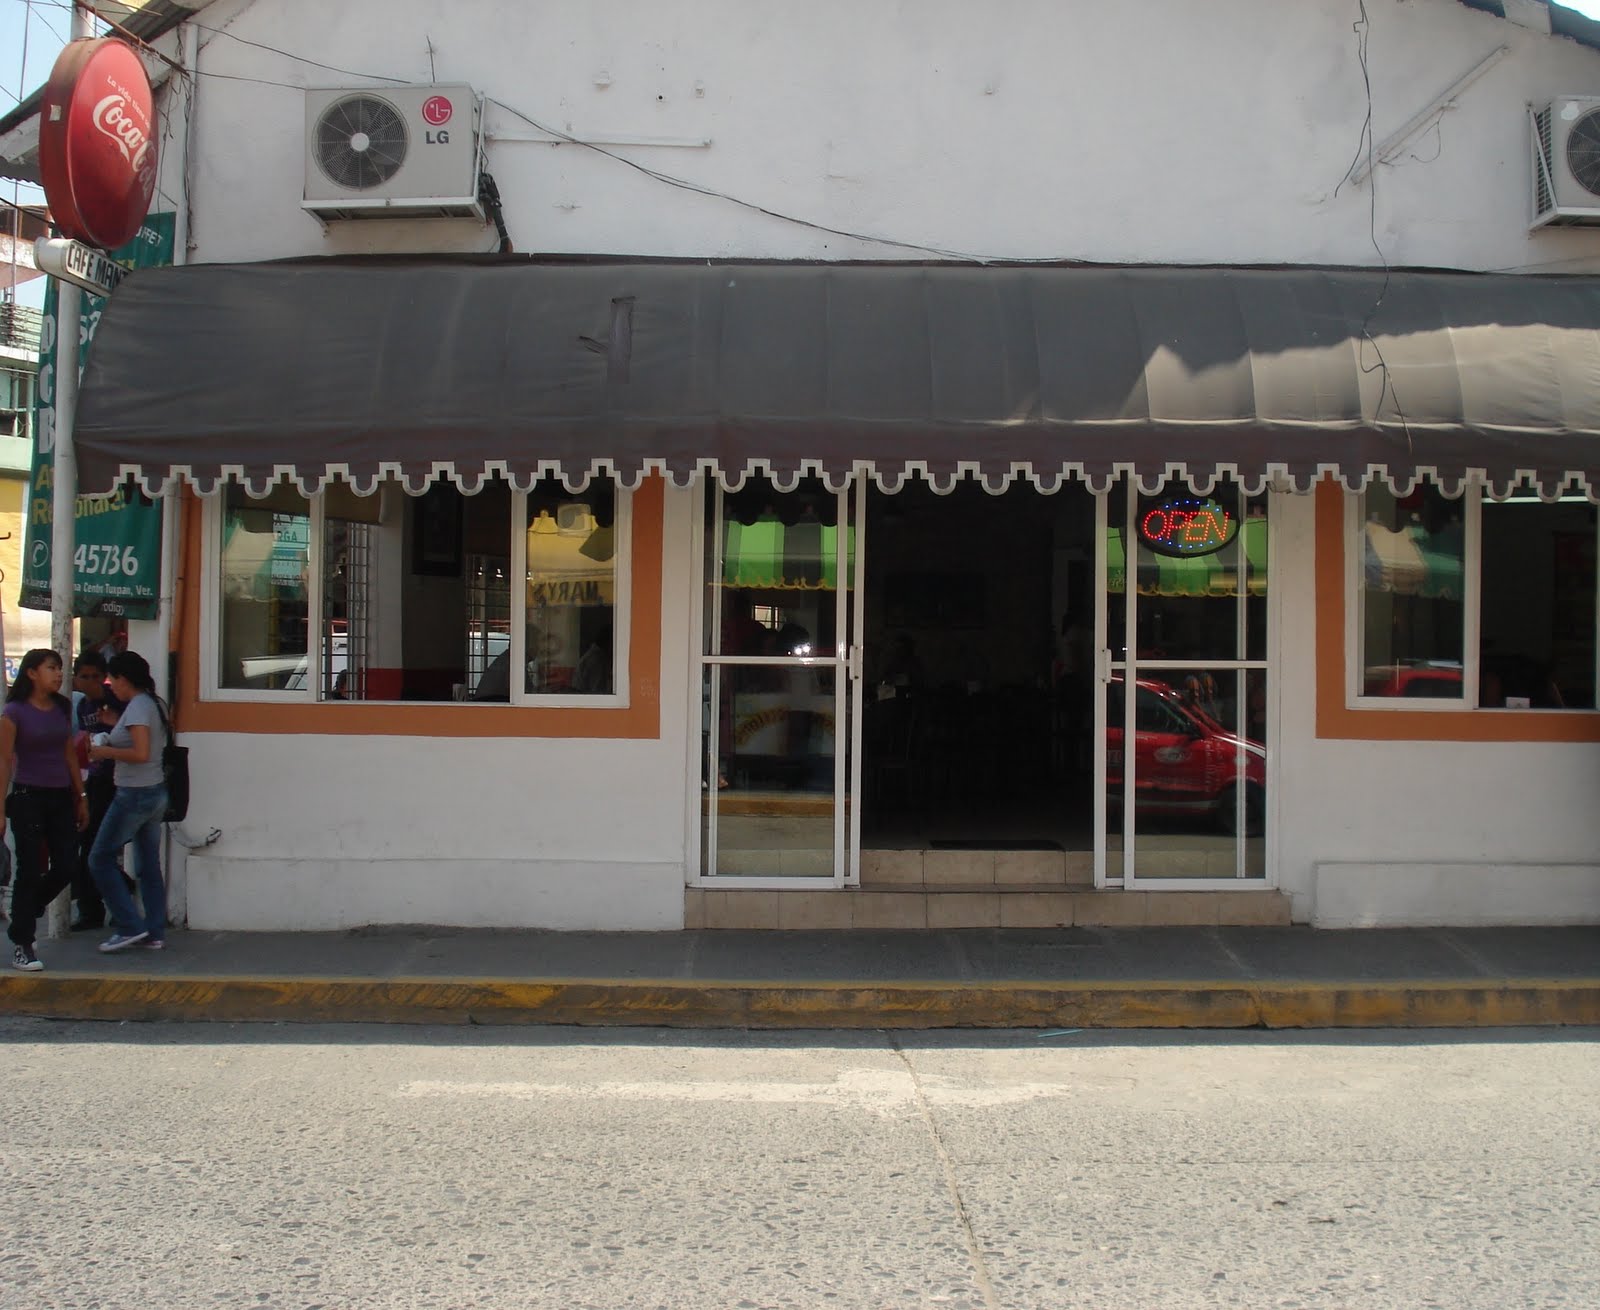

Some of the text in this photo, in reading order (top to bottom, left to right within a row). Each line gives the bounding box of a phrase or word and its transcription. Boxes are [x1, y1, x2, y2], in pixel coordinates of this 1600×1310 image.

[425, 130, 450, 144] LG
[67, 243, 94, 278] CAFE
[1142, 510, 1231, 541] OPEN
[74, 543, 139, 576] 45736
